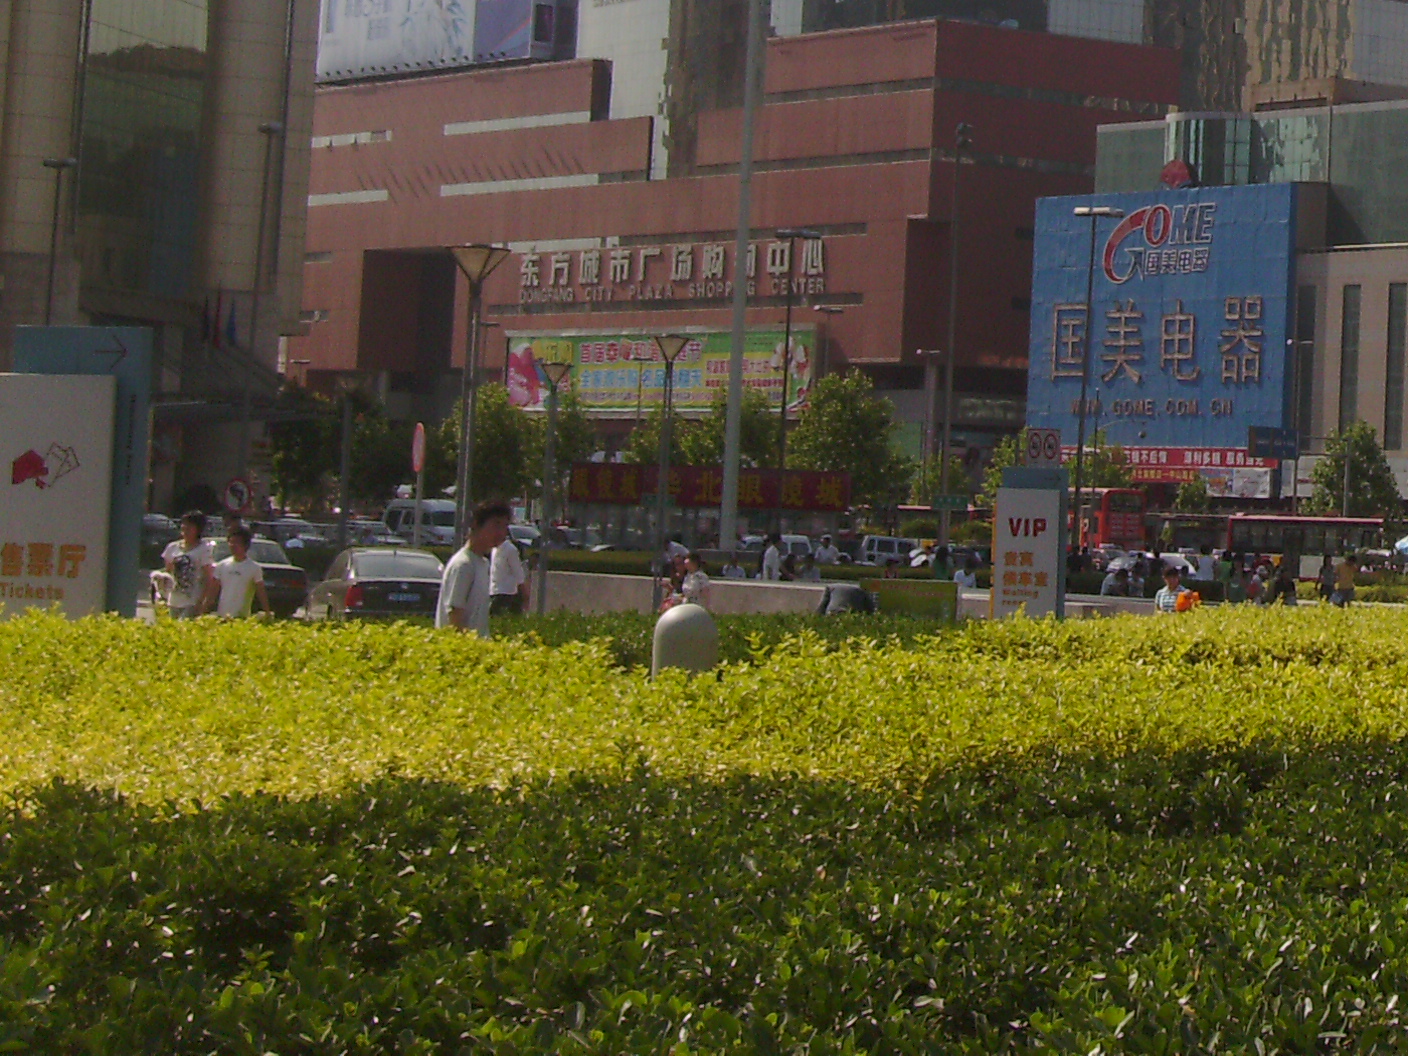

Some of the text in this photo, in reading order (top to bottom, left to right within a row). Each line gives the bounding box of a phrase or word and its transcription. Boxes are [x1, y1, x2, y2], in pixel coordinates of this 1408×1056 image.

[1102, 202, 1216, 285] GOME
[1144, 247, 1210, 275] 国美电器
[584, 285, 613, 302] CITY
[628, 284, 674, 300] PLAZA
[688, 280, 756, 298] SHOPPG
[1051, 295, 1264, 385] 国美电器
[1008, 517, 1048, 538] VIP
[1, 542, 87, 579] 售票厅
[0, 582, 66, 600] Tickets
